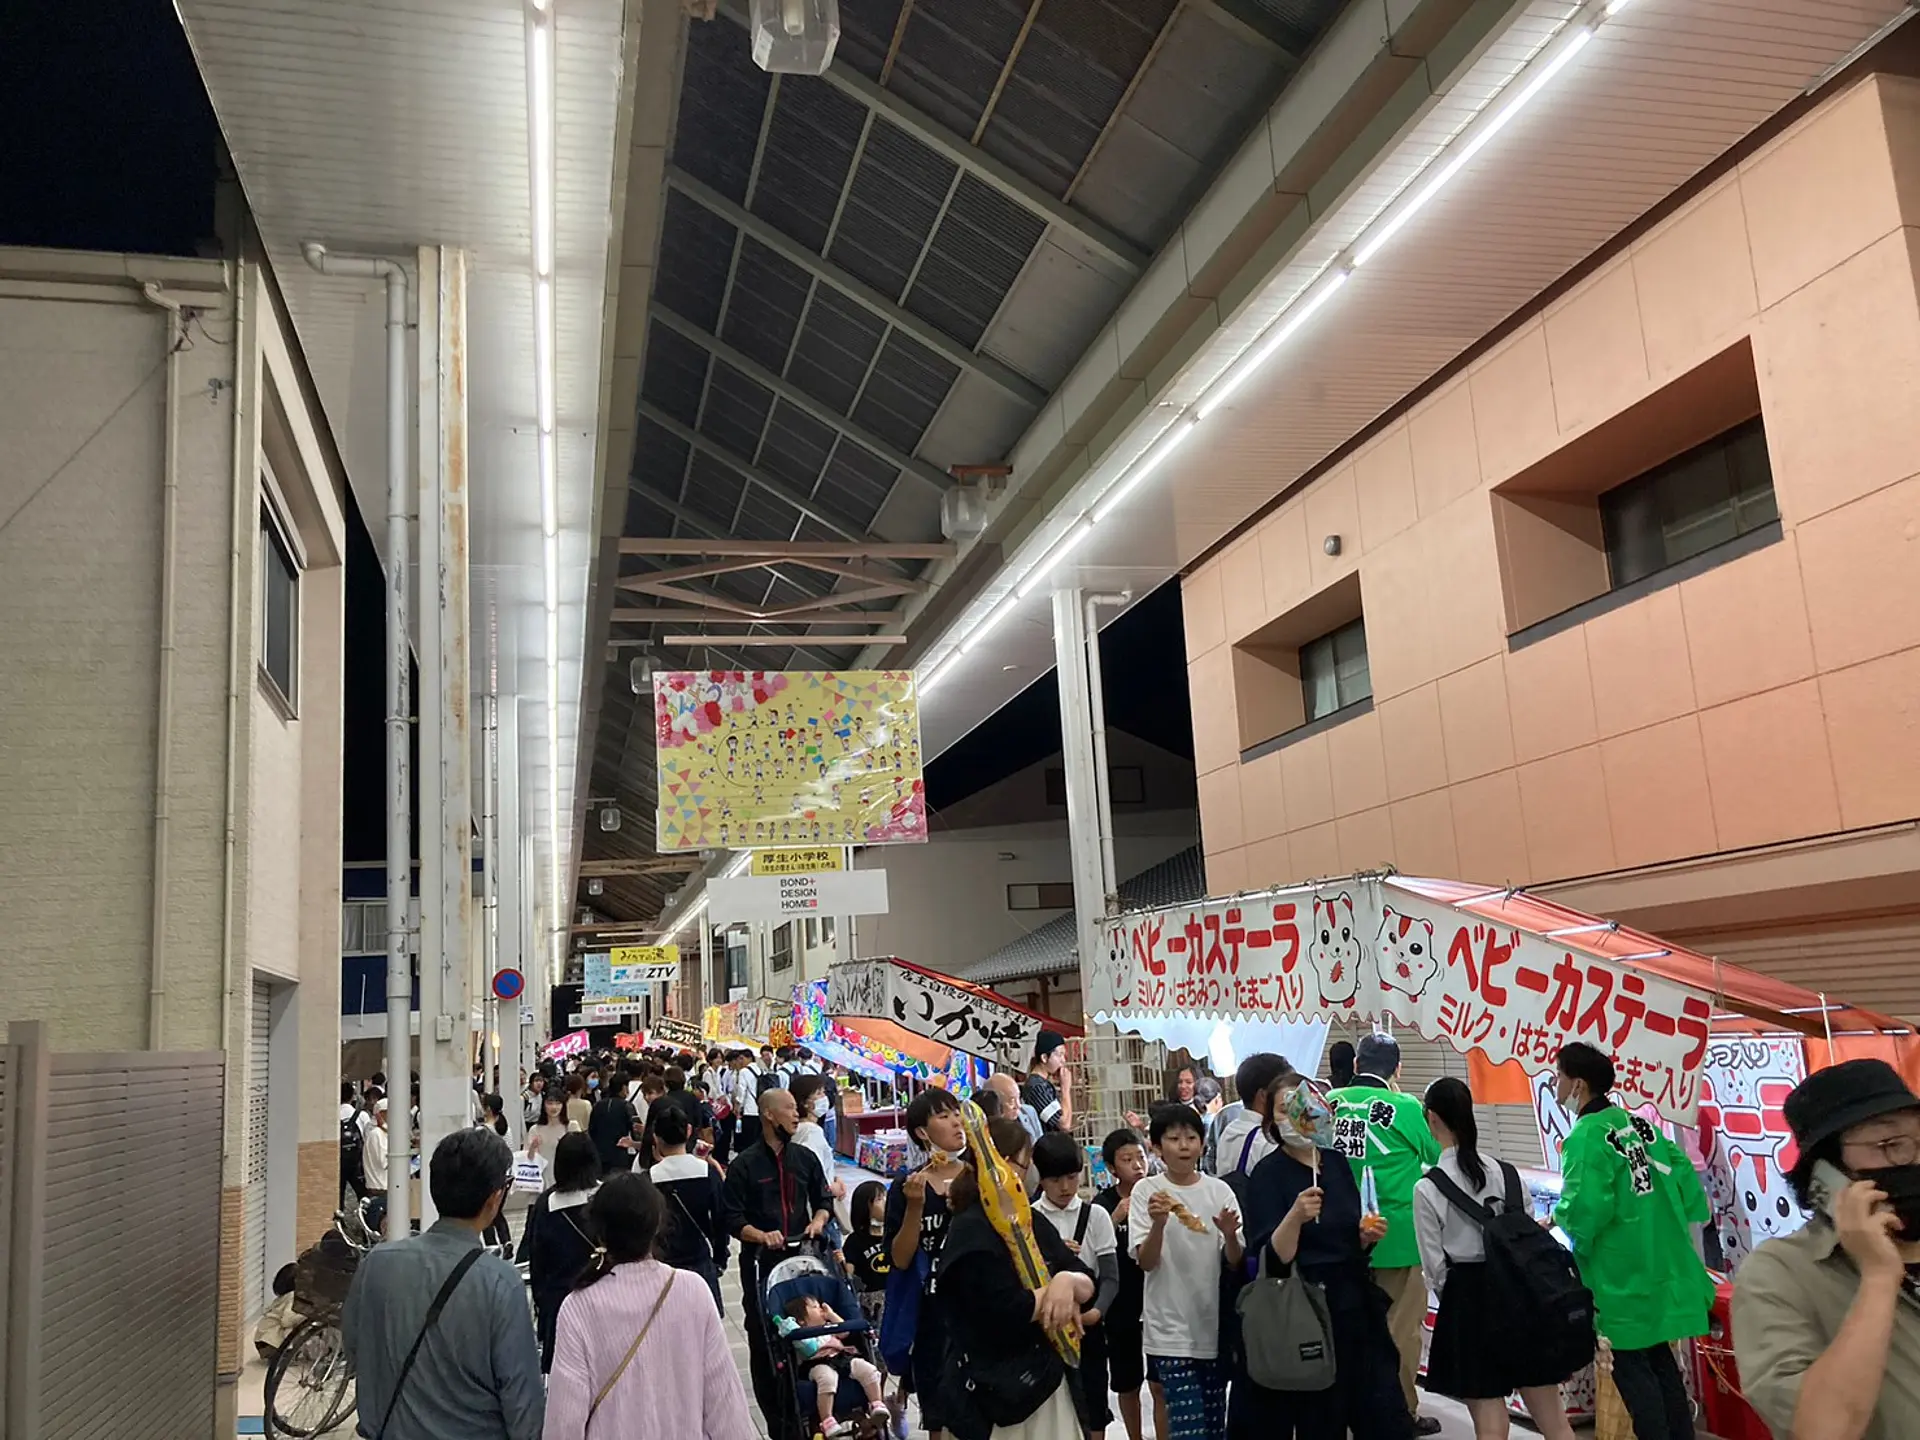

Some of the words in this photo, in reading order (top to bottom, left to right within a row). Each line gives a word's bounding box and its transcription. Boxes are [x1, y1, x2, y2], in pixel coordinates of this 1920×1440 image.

[763, 851, 829, 863] 厚生小学校
[781, 888, 817, 898] DESIGN
[1133, 903, 1300, 976] ベビーカステーラ
[645, 966, 676, 979] ZTV
[1138, 974, 1304, 1011] ミルク・はちみつ・たまご入り
[1448, 923, 1710, 1071] ベビーカステーラ
